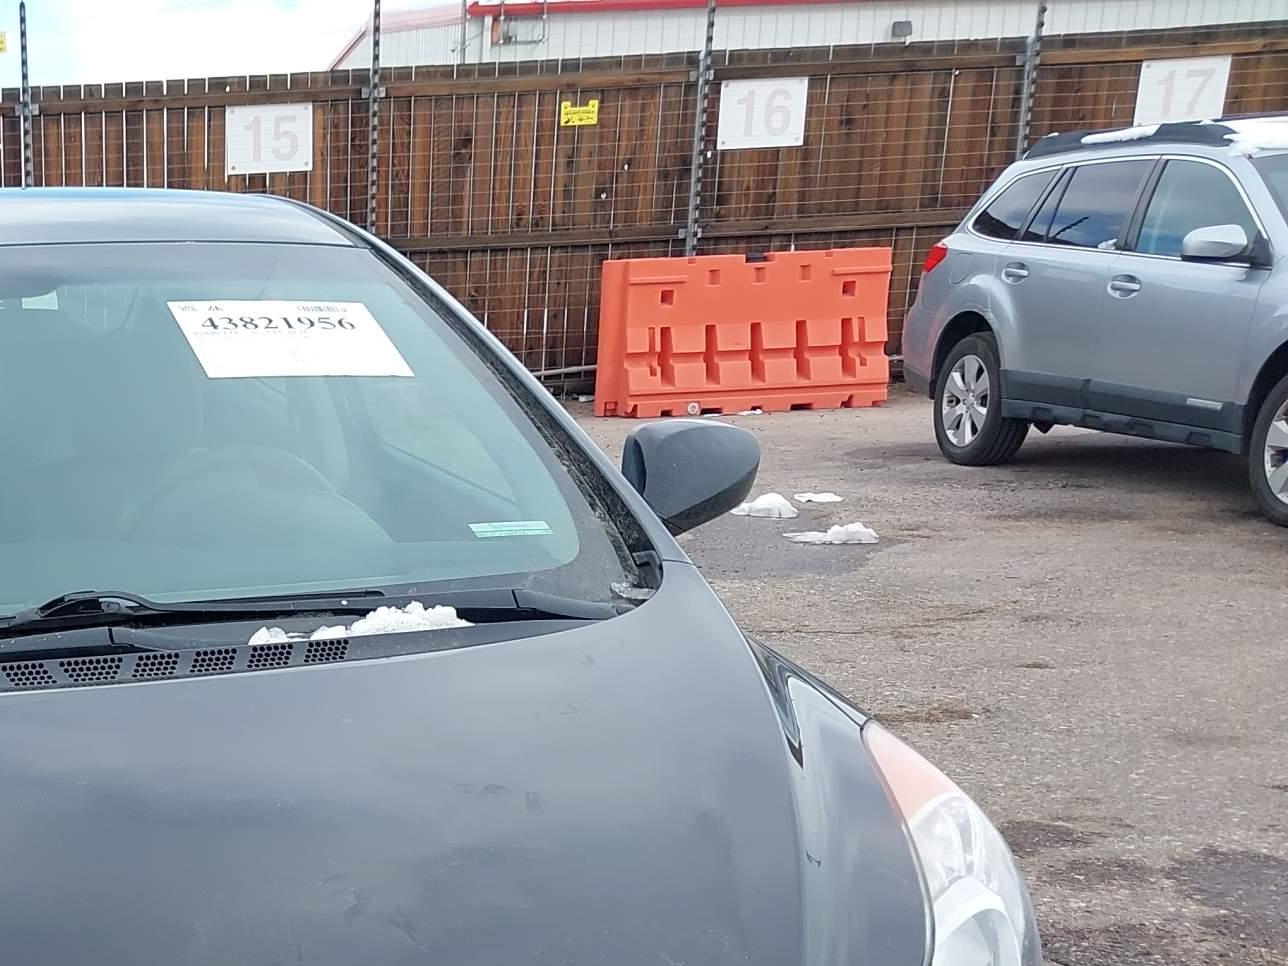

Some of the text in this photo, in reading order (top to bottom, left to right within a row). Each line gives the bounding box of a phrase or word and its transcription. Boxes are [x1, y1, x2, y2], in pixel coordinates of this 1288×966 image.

[737, 88, 792, 137] 16
[1156, 68, 1216, 117] 17
[243, 115, 298, 161] 15
[201, 316, 356, 330] 43821956
